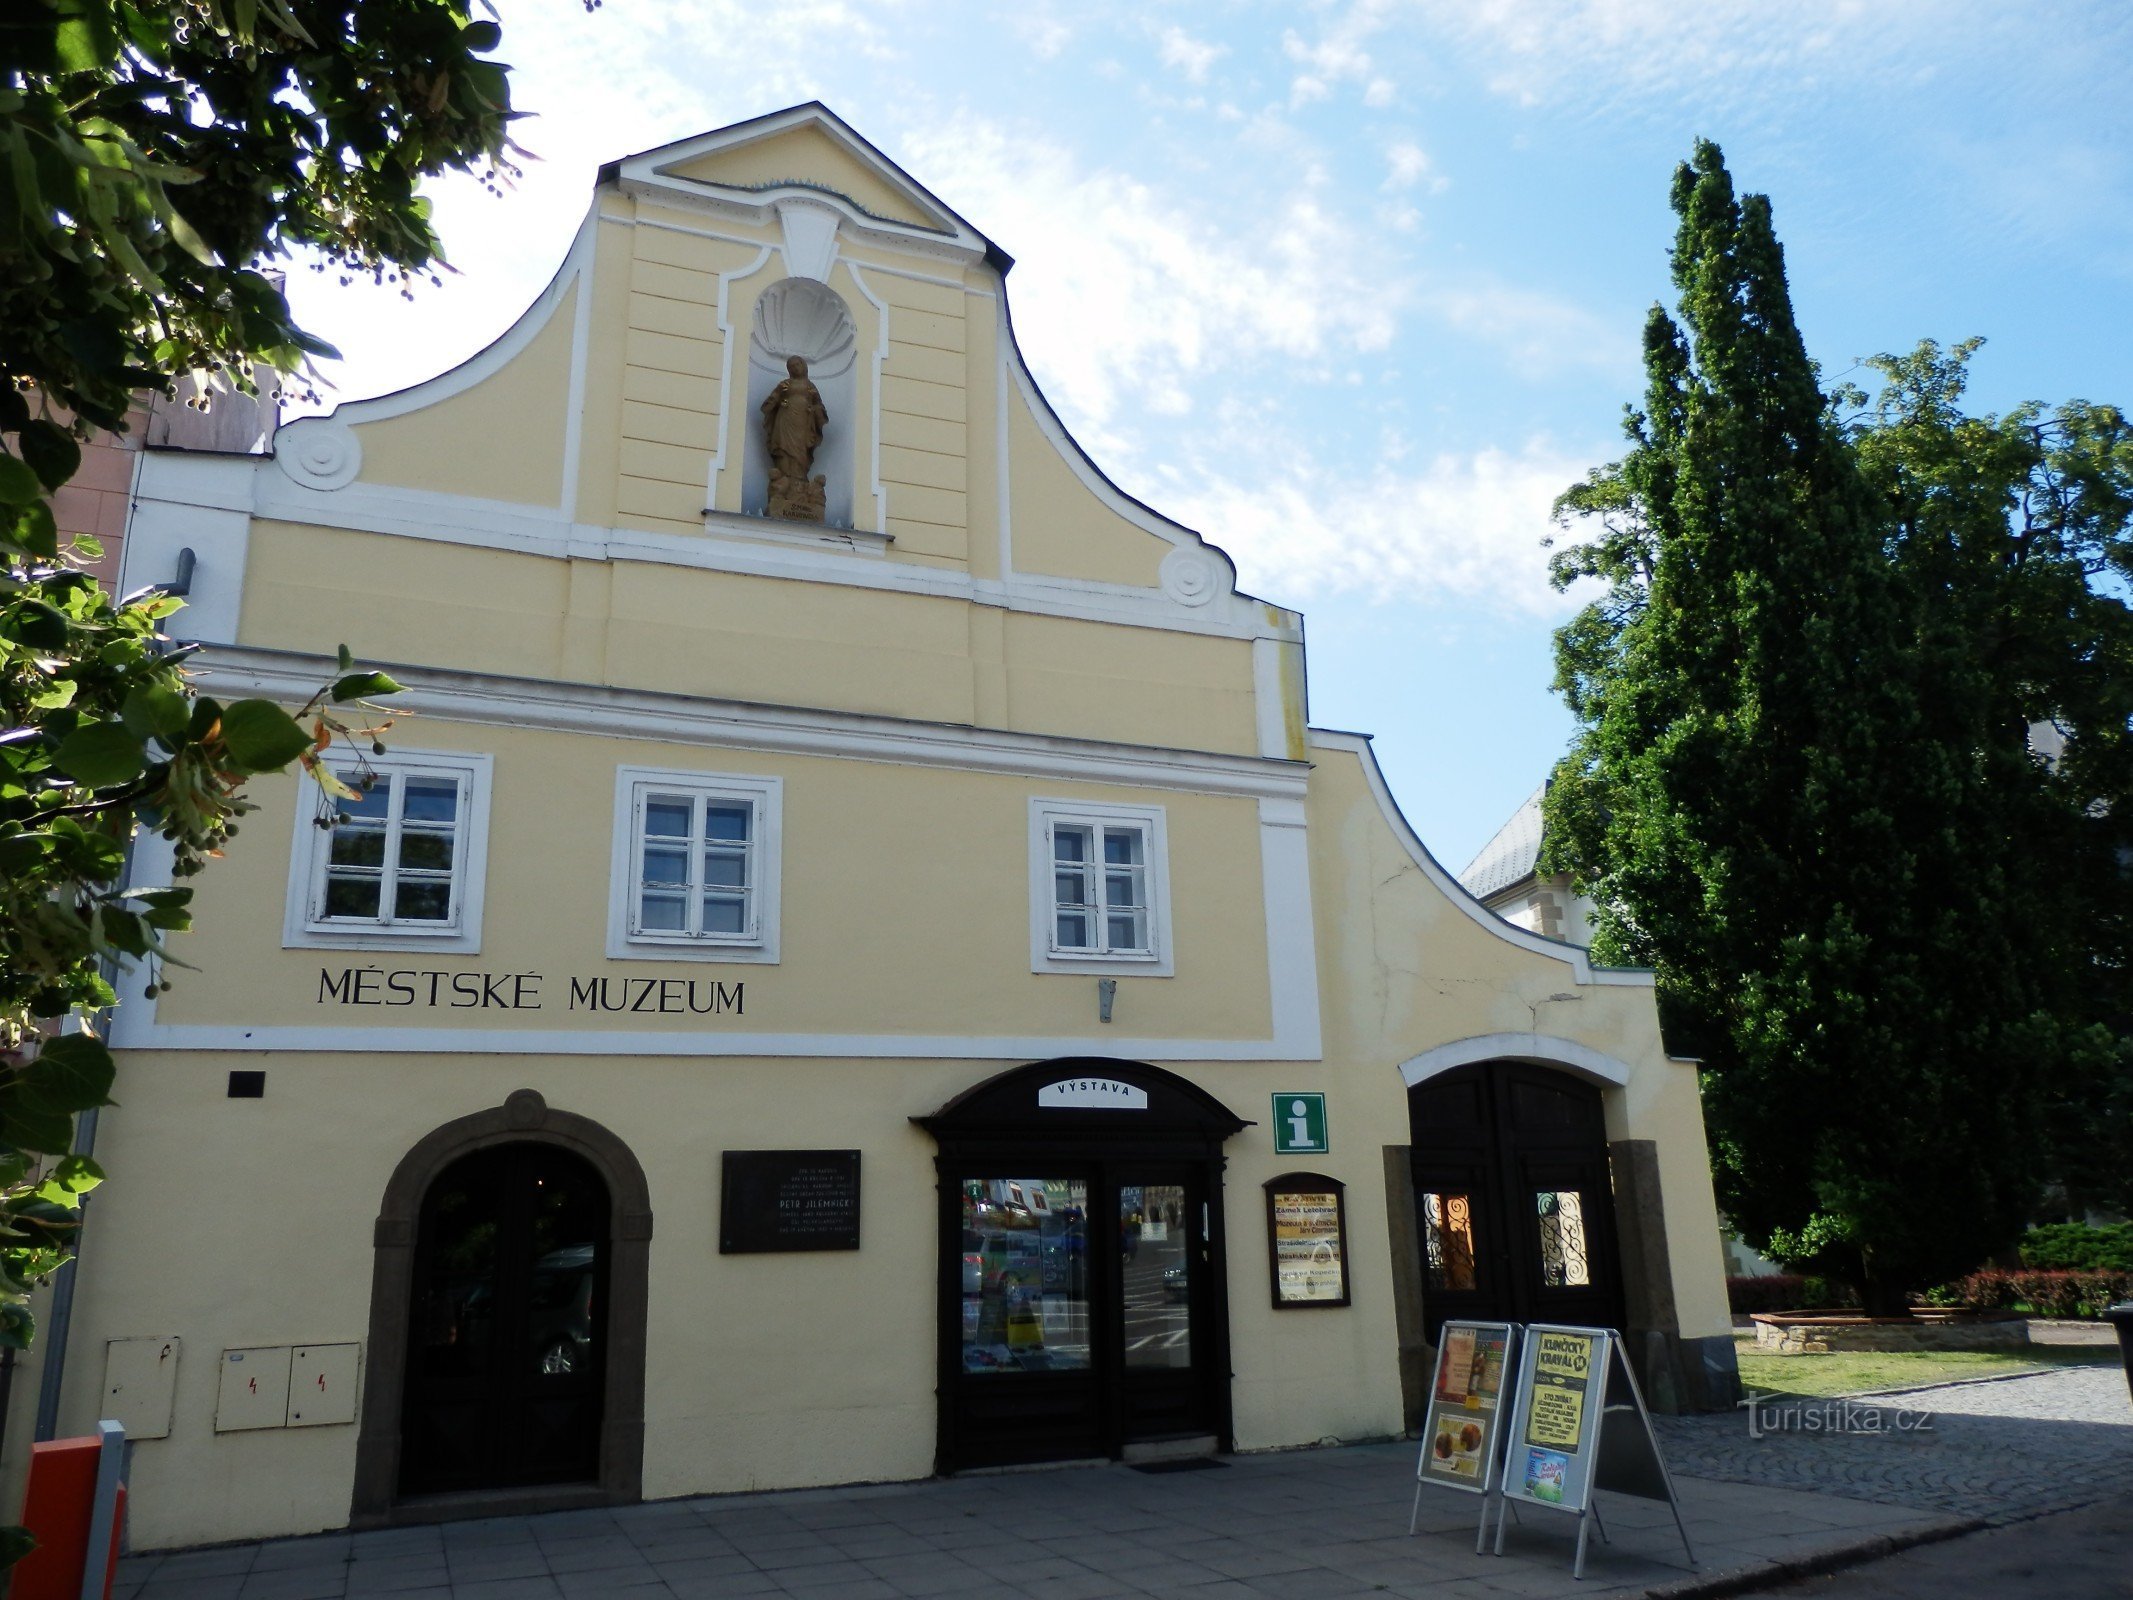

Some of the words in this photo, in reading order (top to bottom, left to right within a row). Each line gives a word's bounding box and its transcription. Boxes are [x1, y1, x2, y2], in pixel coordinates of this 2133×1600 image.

[316, 964, 543, 1010] MĚSTSKÉ
[569, 976, 746, 1016] MUZEUM
[1057, 1079, 1129, 1096] VÝSTAVA
[780, 1199, 801, 1209] PETR
